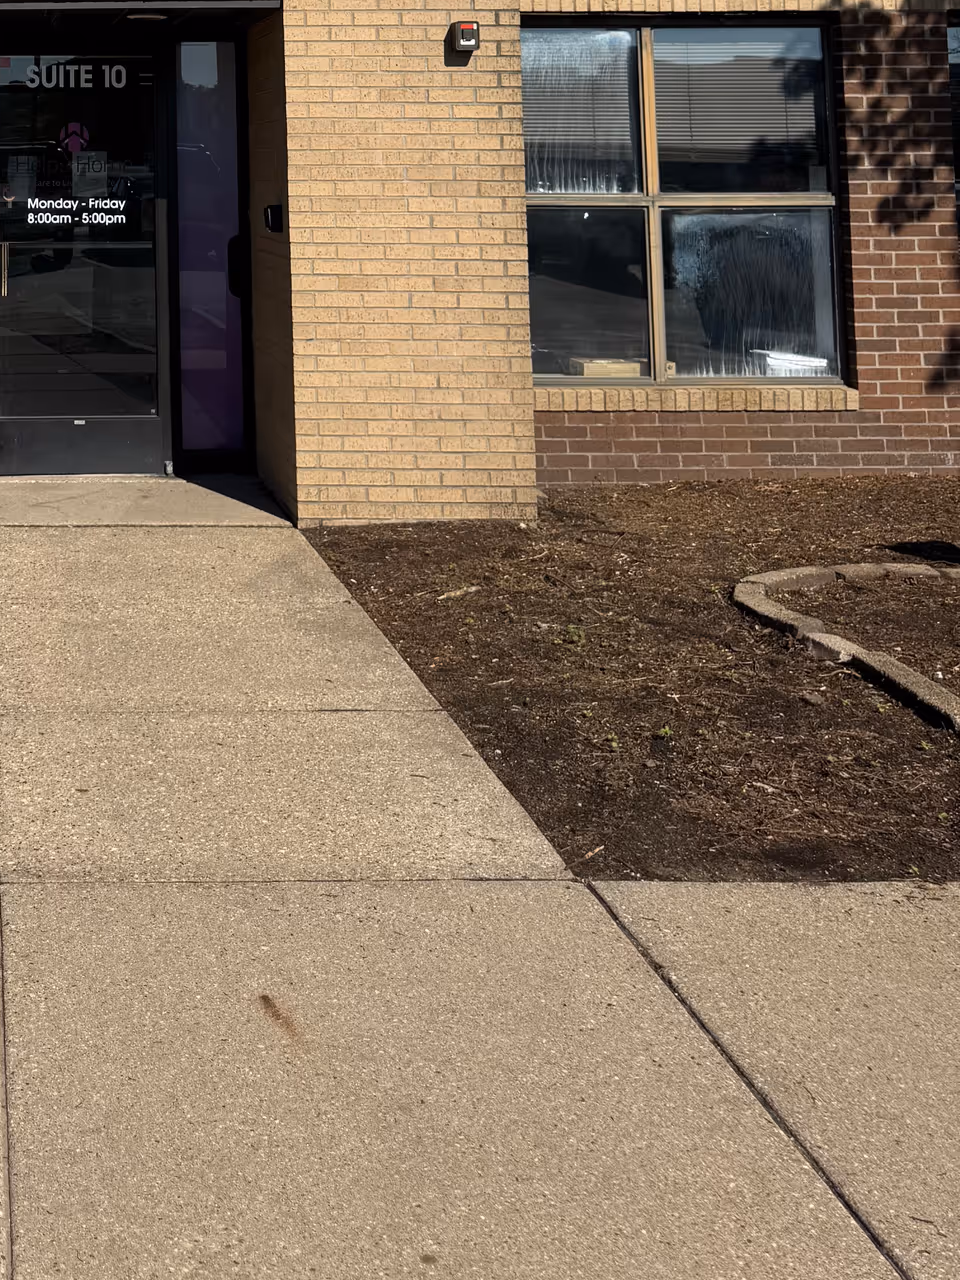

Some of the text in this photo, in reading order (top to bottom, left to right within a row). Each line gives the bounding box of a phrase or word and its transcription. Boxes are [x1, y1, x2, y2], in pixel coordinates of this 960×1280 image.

[25, 65, 127, 89] SUITE 10
[27, 197, 79, 211] Monday
[88, 197, 126, 211] Friday
[27, 212, 72, 224] 8:00am
[81, 212, 126, 226] 5:00pm
